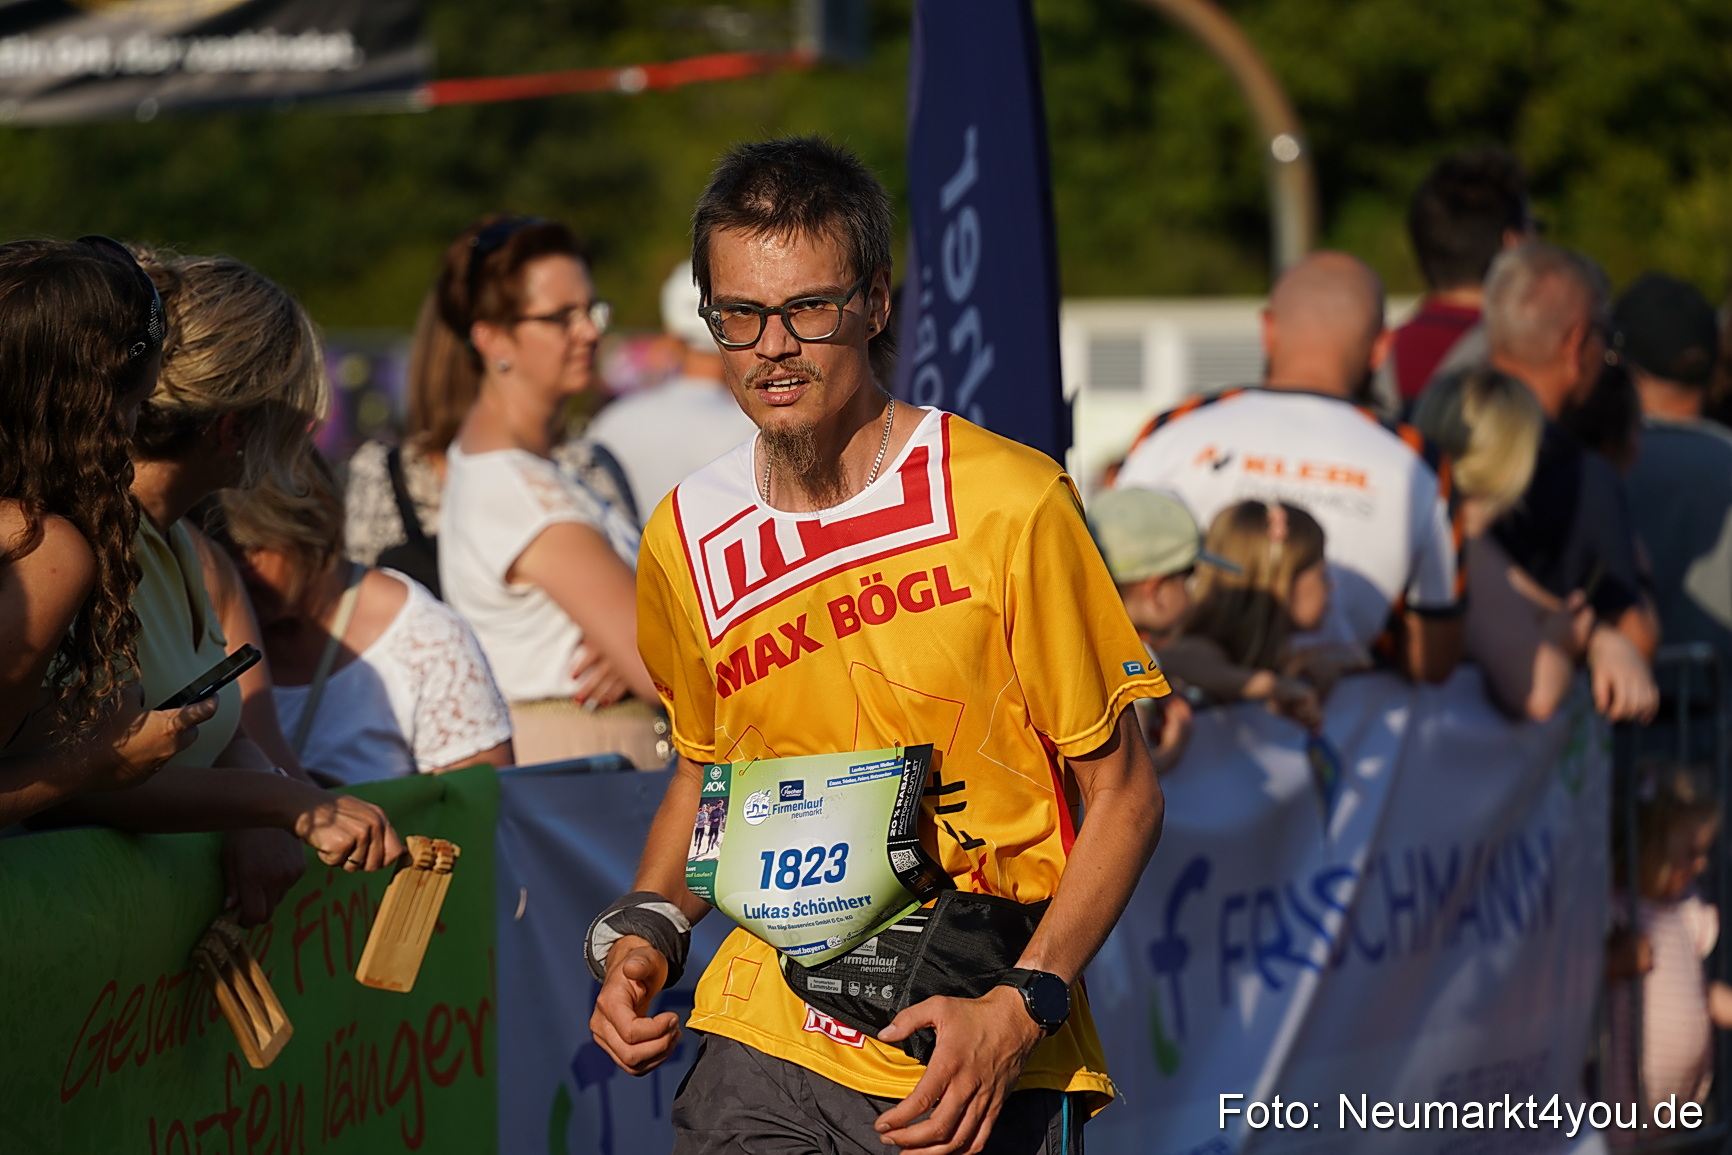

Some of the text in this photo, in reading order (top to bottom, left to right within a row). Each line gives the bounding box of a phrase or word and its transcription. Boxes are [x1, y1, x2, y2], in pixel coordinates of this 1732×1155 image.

[715, 565, 972, 700] MAX BÖGL
[702, 780, 726, 793] AOK
[889, 819, 898, 837] 20
[896, 759, 912, 808] RABATT
[897, 795, 911, 836] FACTORY
[906, 759, 919, 794] OUTLET
[772, 797, 824, 815] Firmenlauf
[790, 808, 823, 820] neumarkt
[760, 842, 849, 890] 1823
[743, 894, 872, 920] Lukas Schönherr
[1217, 829, 1555, 1007] FRISCHMANN
[787, 921, 815, 930] Bauservice
[815, 918, 832, 927] GmbH
[860, 965, 897, 974] neumarkt
